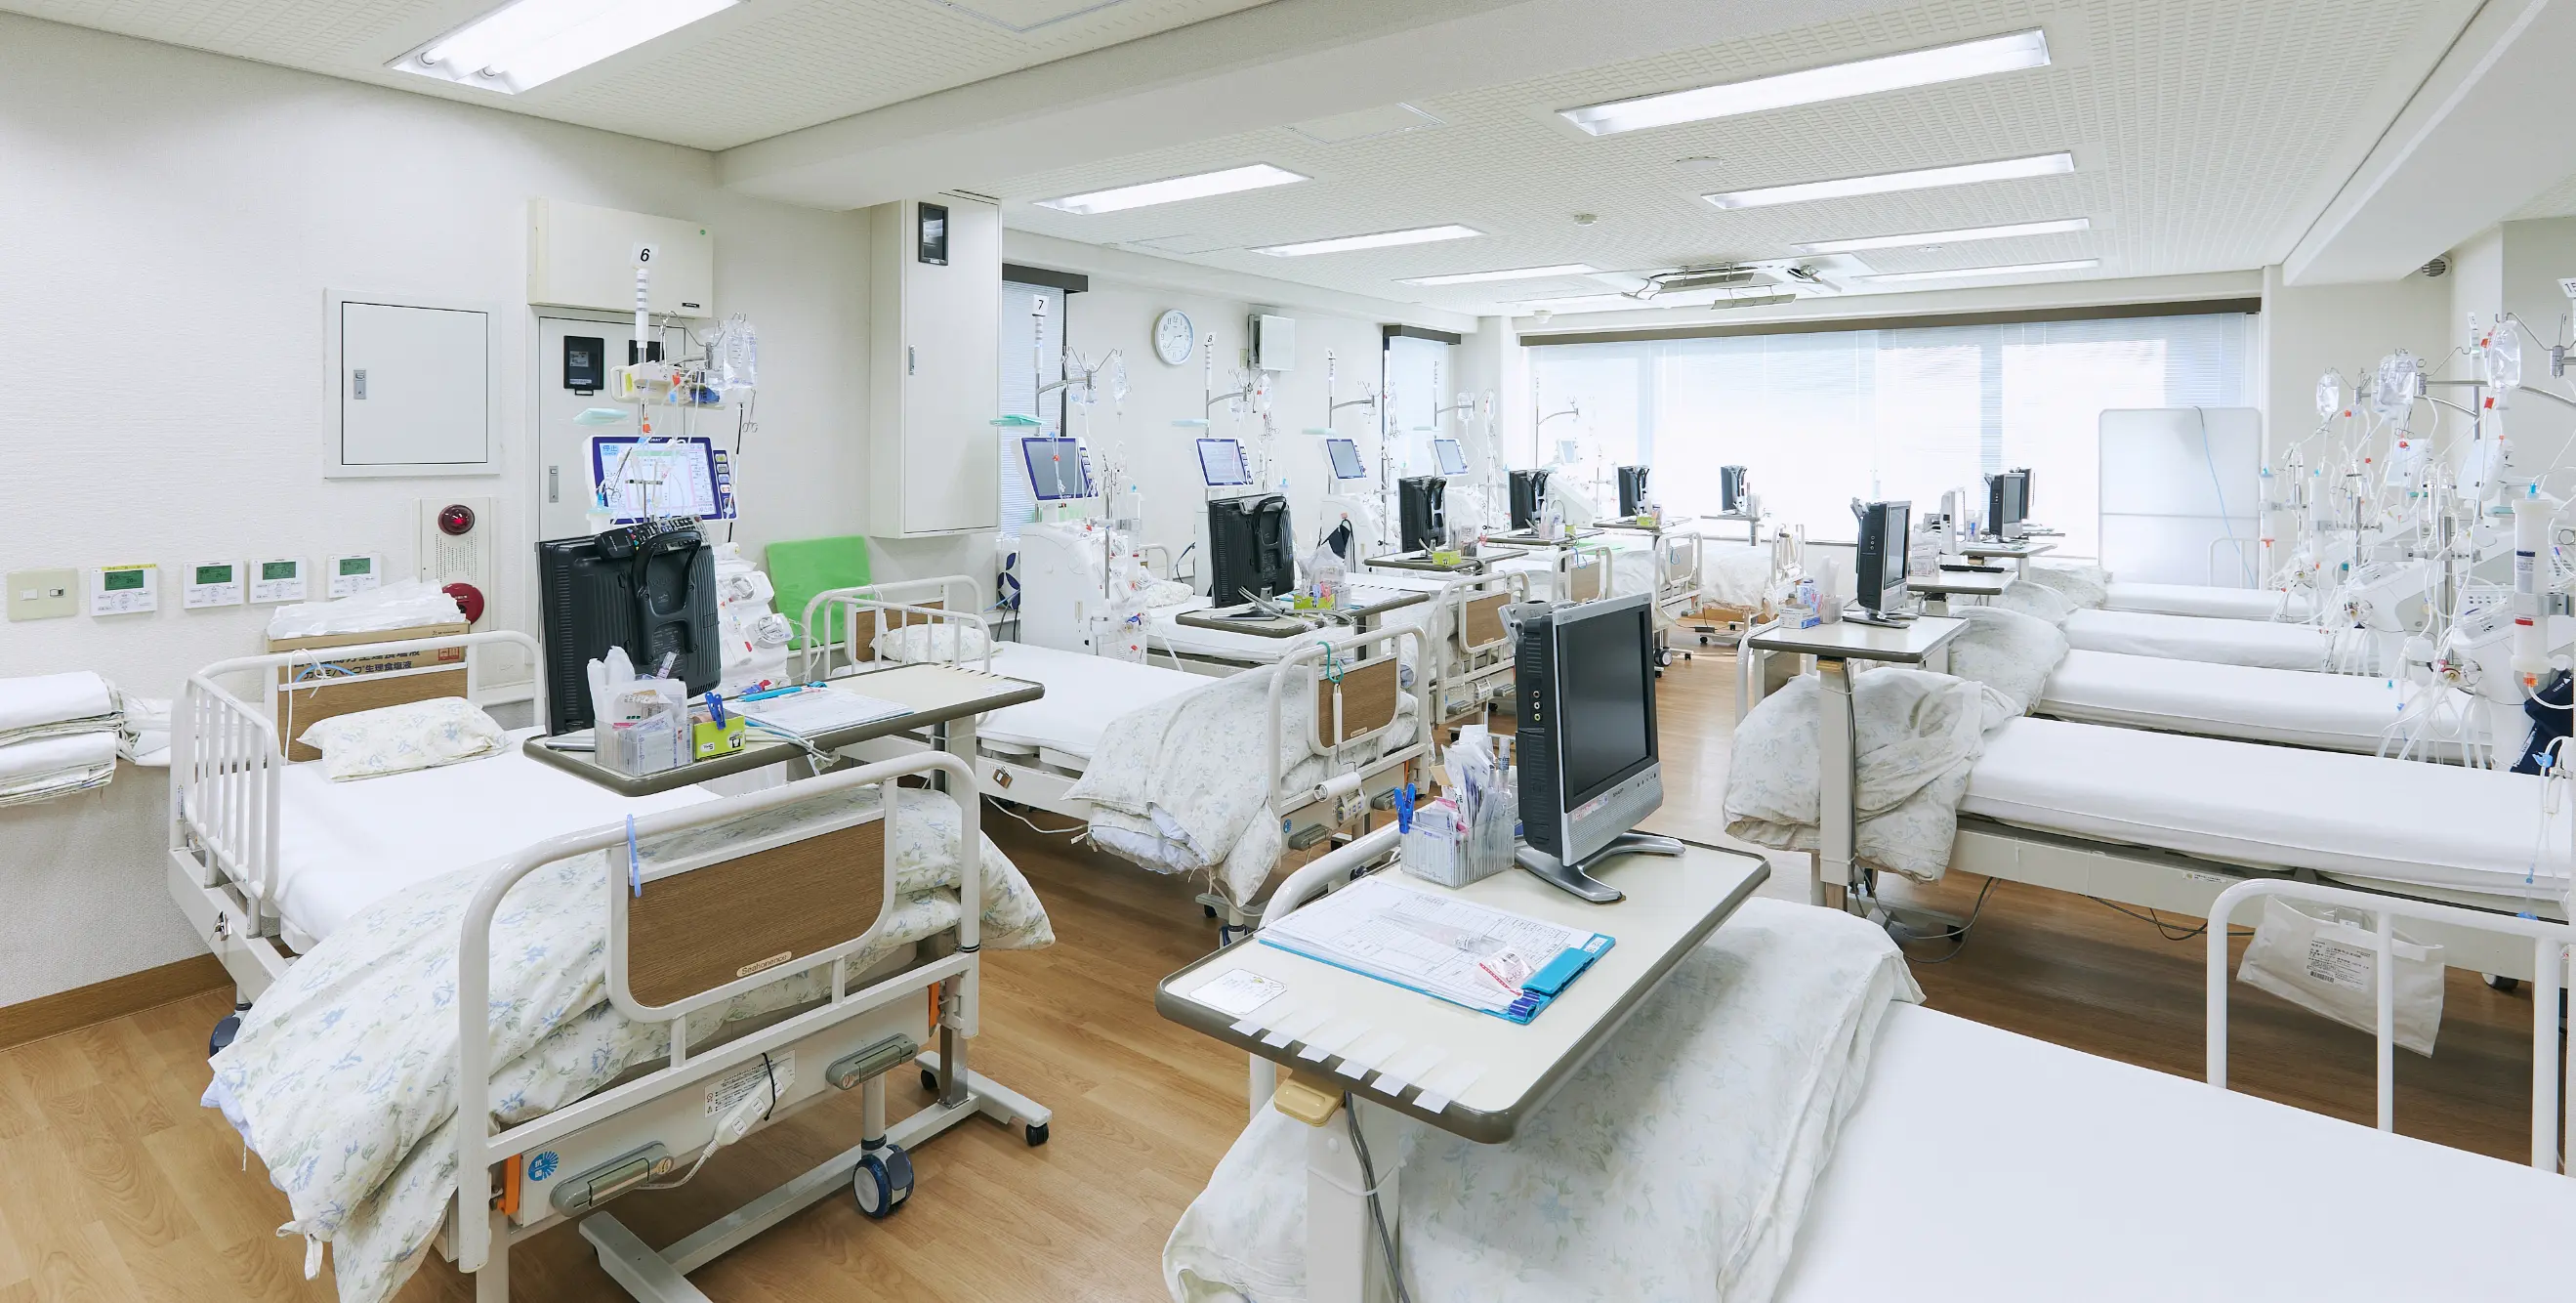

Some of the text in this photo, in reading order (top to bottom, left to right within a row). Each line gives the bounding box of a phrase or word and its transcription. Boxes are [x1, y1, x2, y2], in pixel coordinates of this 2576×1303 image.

[640, 248, 650, 262] 6
[1038, 299, 1044, 310] 7
[1207, 334, 1213, 343] 8
